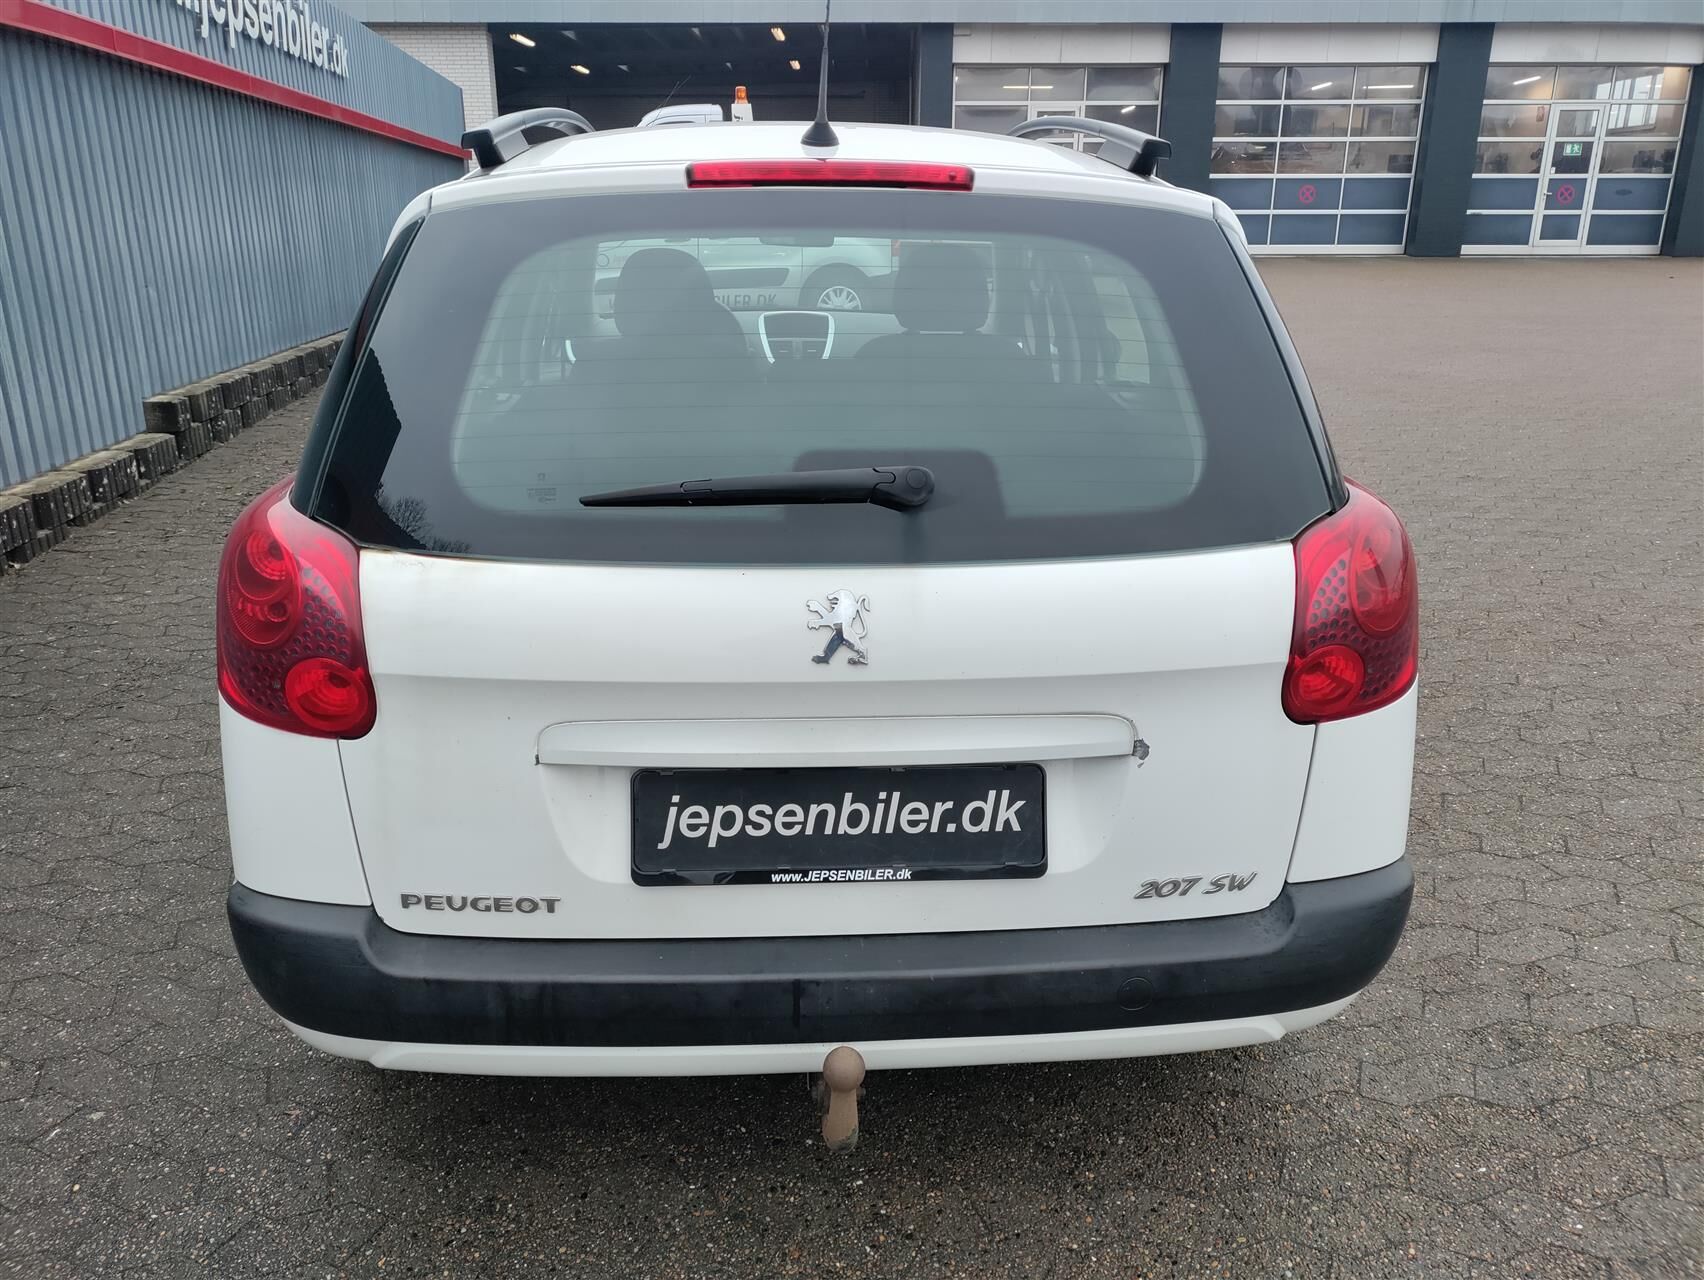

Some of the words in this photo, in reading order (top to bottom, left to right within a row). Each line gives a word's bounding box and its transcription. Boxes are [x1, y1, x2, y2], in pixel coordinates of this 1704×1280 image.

[658, 790, 1026, 849] jepsenbiler.dk
[771, 869, 912, 882] www.JEPSENBILER.dk
[1133, 876, 1203, 900] 207
[1201, 871, 1258, 895] SW
[400, 893, 561, 913] PEUGEOT
